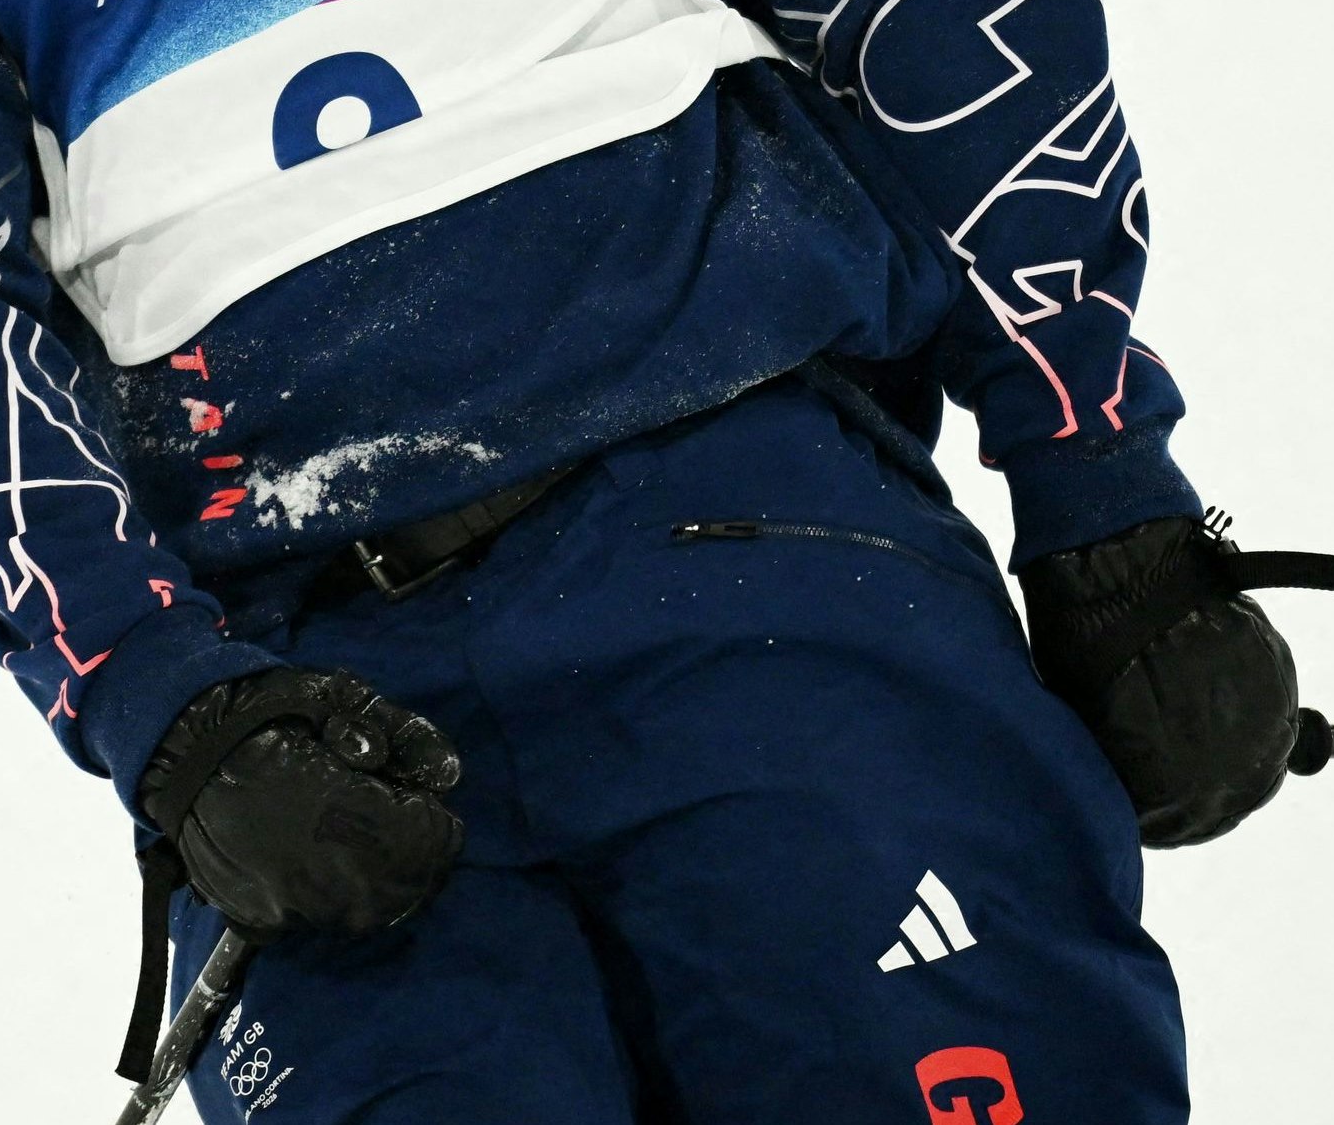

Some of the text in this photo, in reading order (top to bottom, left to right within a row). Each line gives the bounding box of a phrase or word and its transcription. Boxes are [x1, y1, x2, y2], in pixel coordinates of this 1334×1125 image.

[220, 1020, 265, 1082] TEAM GB
[264, 1066, 295, 1096] CORTINA
[261, 1092, 279, 1109] 2026
